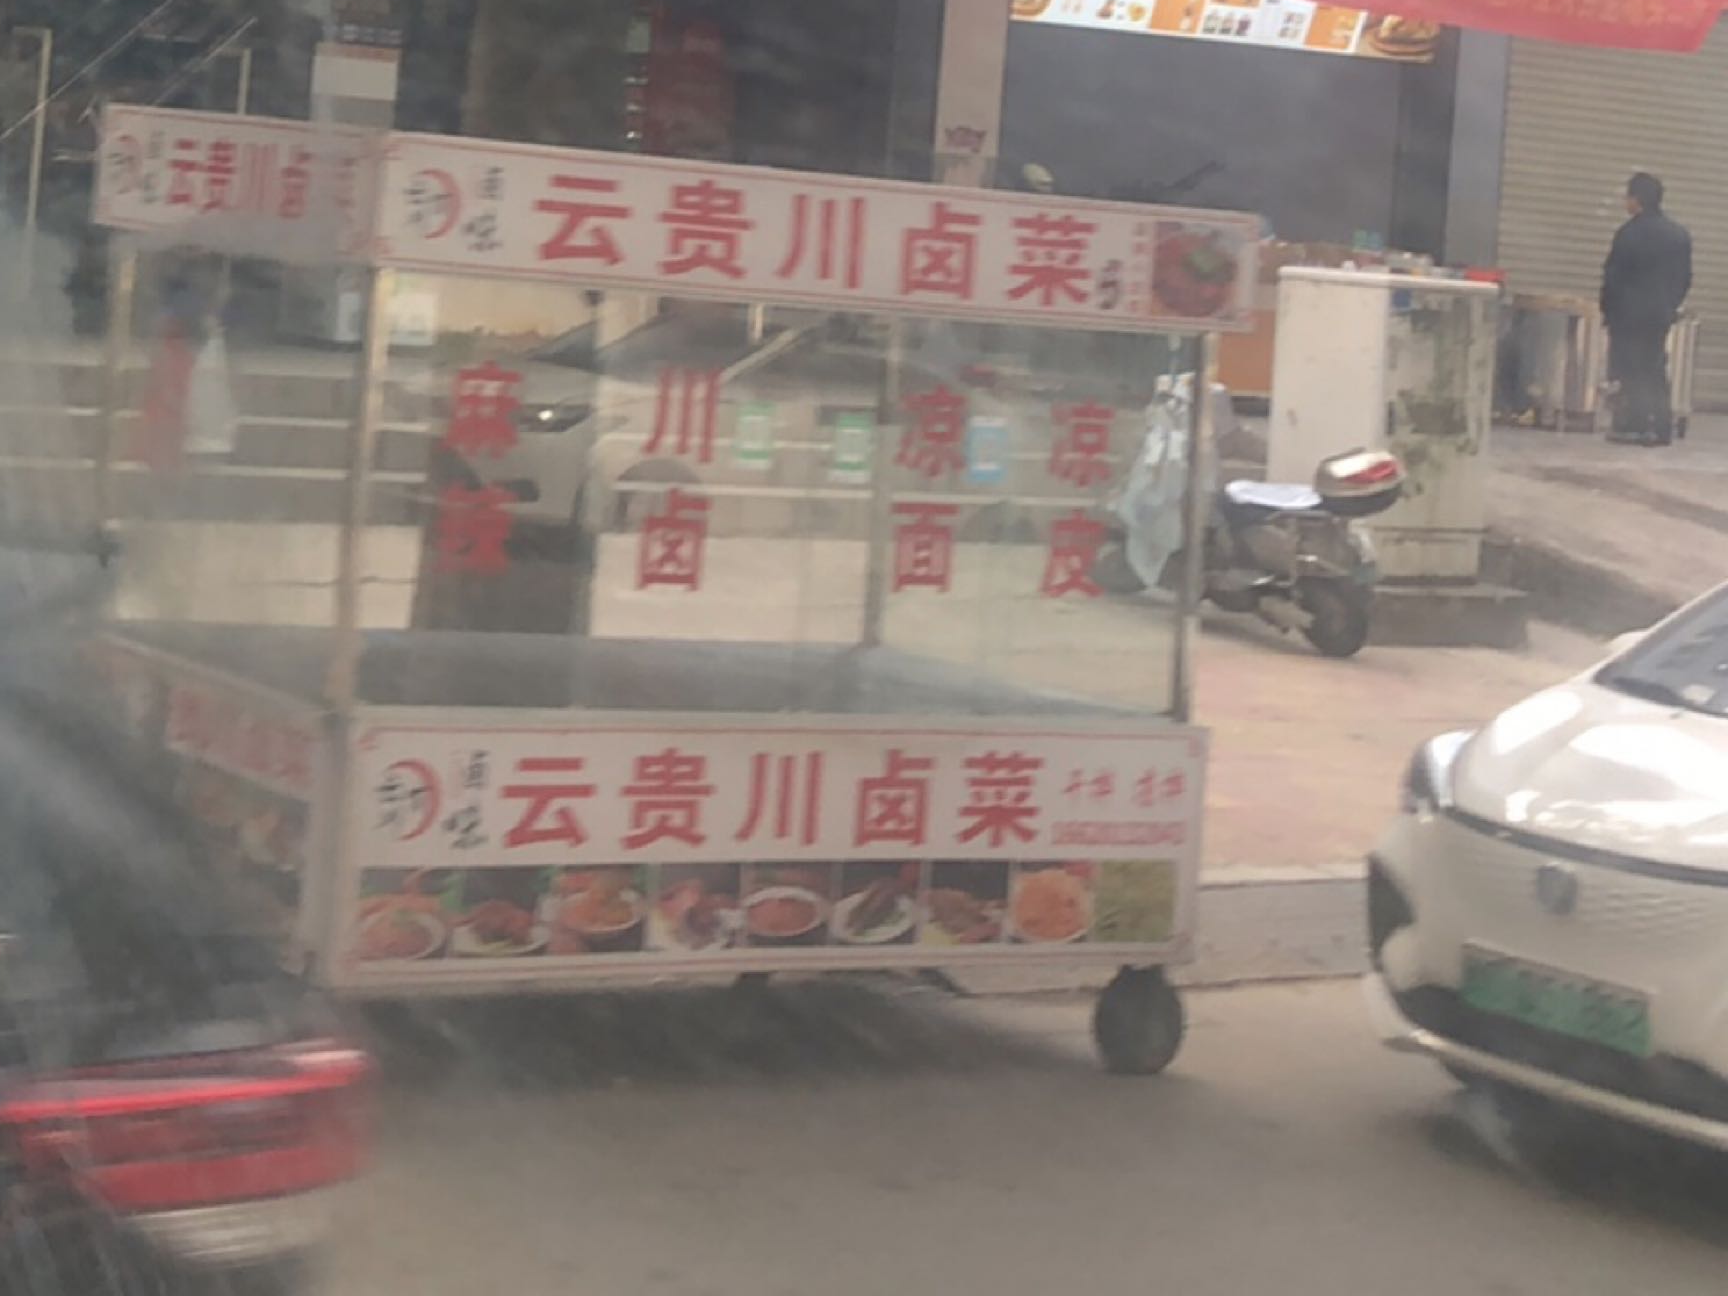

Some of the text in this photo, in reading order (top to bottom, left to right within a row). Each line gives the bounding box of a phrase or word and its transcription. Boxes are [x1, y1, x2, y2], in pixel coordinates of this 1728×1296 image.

[534, 174, 1098, 308] 云贵川卤菜
[498, 746, 1046, 850] 云贵川卤菜
